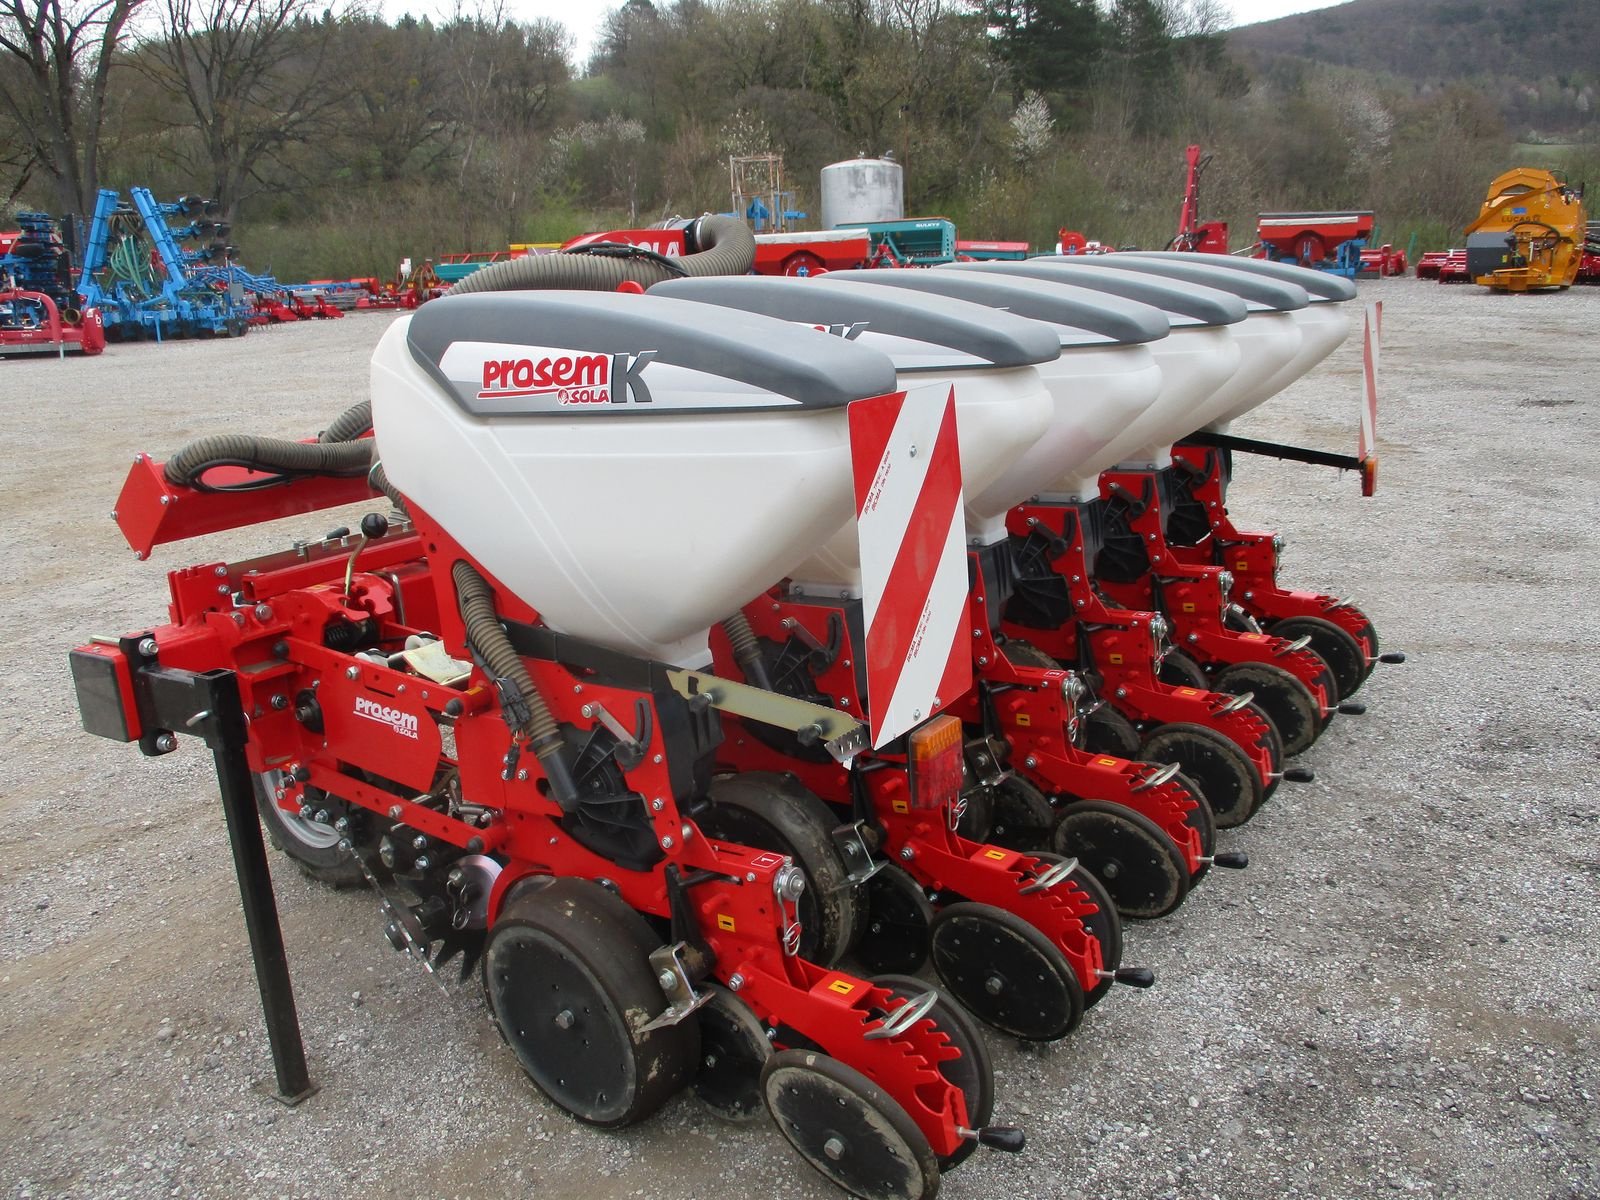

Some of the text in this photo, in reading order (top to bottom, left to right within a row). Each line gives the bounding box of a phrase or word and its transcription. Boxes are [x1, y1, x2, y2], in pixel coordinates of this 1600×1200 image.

[483, 350, 658, 404] prosem K
[569, 389, 610, 404] SOLA
[355, 696, 418, 731] prosem
[399, 728, 419, 740] SOLA
